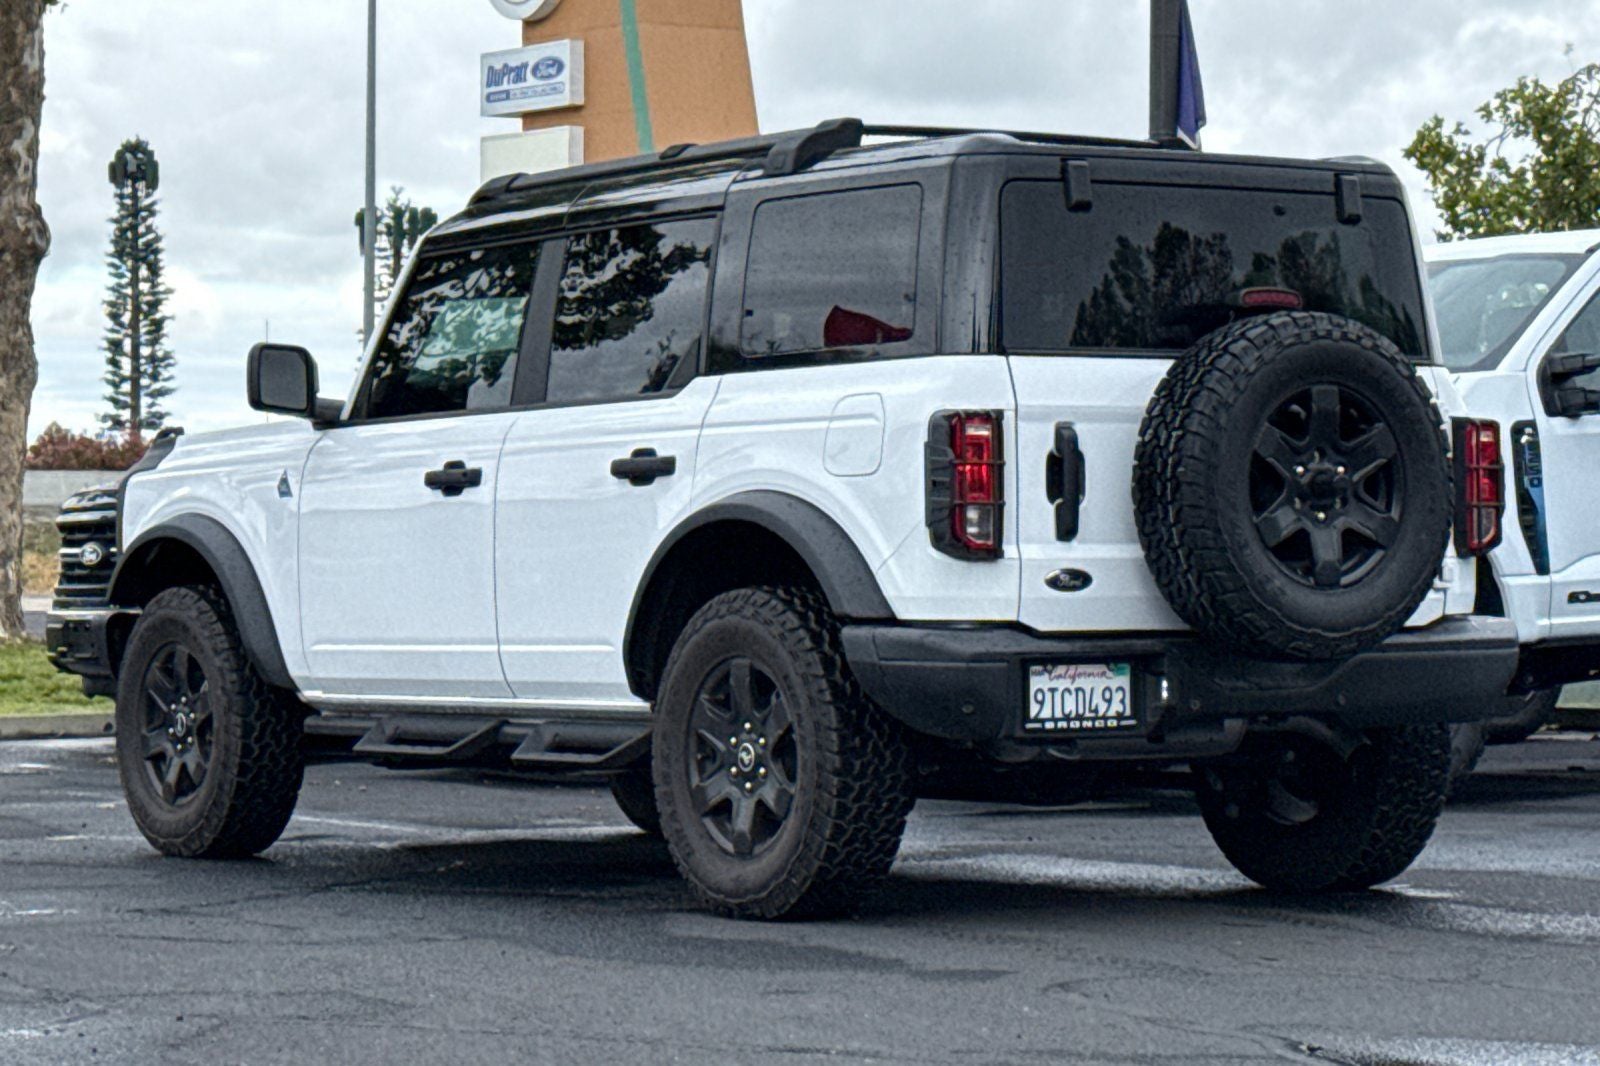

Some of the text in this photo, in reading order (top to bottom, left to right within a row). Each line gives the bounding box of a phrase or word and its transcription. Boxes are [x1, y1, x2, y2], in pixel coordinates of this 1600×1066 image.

[486, 61, 529, 87] DuPratt
[1048, 664, 1114, 685] California
[1033, 686, 1126, 720] 9TCD493
